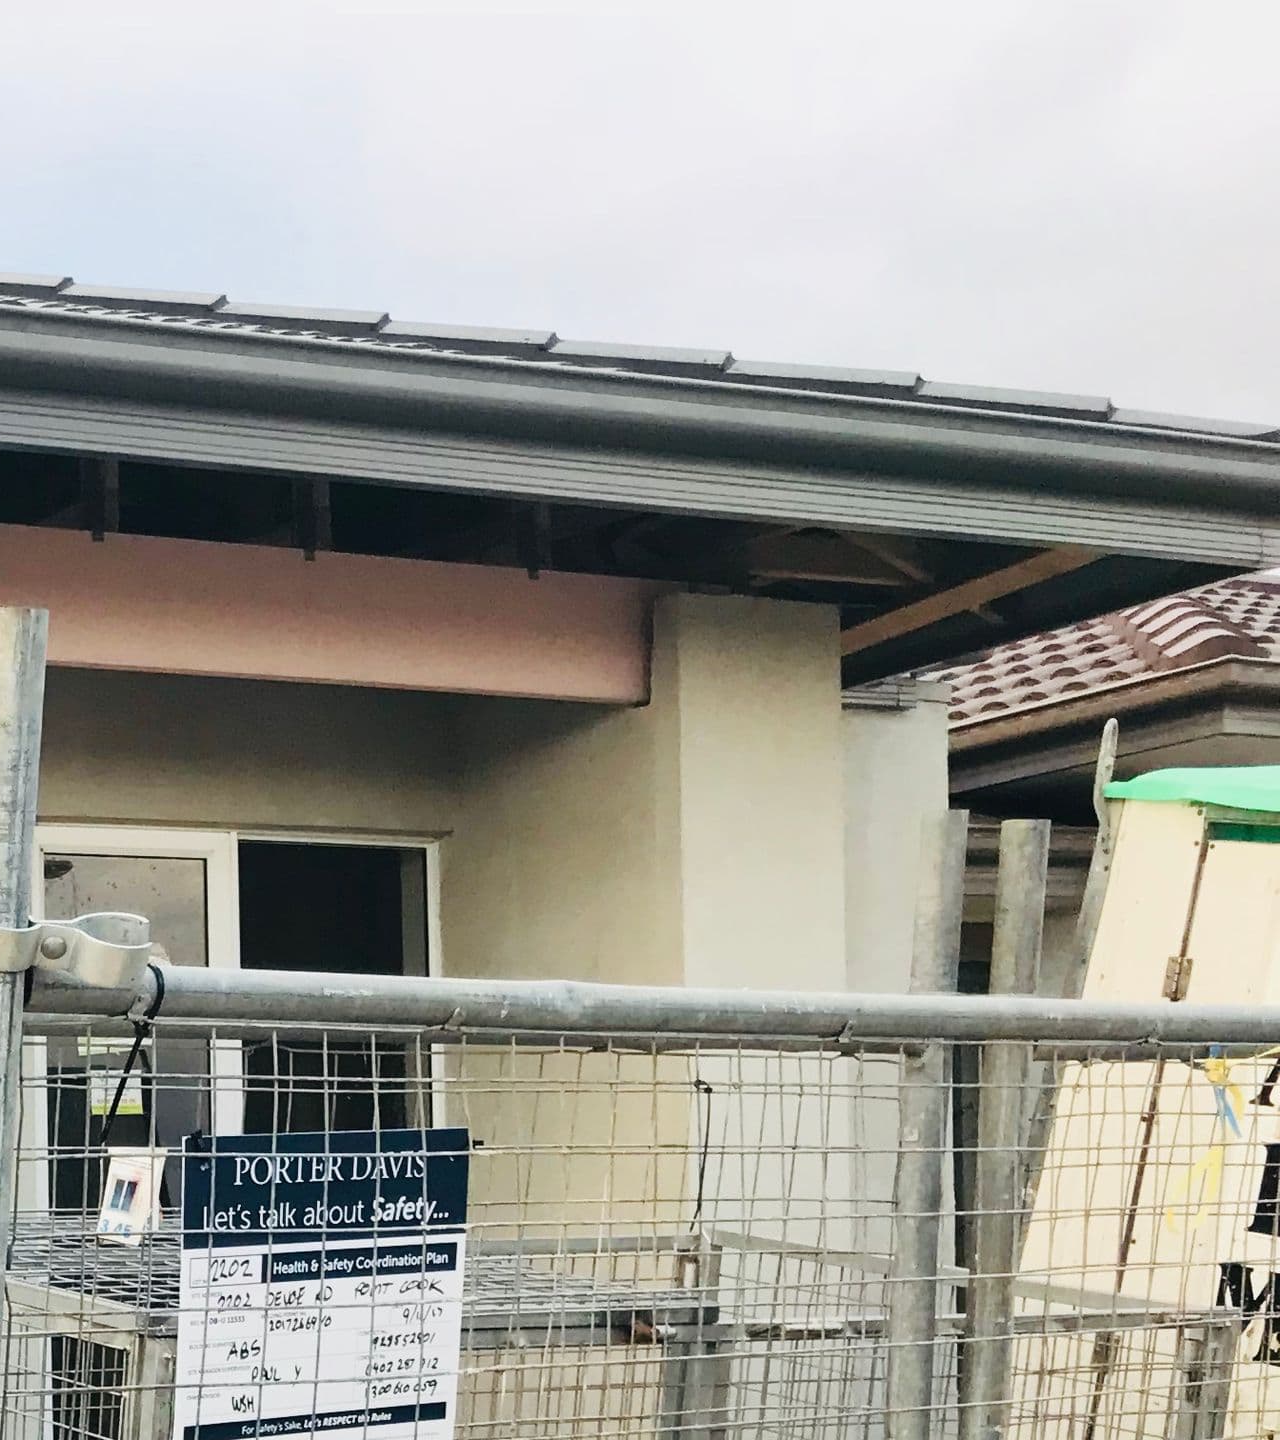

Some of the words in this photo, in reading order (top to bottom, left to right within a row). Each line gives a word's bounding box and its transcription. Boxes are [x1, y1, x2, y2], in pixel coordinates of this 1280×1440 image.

[234, 1155, 344, 1186] PORTER
[351, 1151, 426, 1179] DAVIS
[203, 1203, 251, 1231] Let's
[258, 1201, 297, 1229] talk
[304, 1200, 365, 1227] about
[370, 1195, 450, 1226] Safety...
[273, 1257, 309, 1275] Health
[311, 1259, 319, 1272] &
[321, 1256, 354, 1275] Safety
[356, 1252, 424, 1271] Coordination
[426, 1251, 449, 1266] Plan
[227, 1339, 261, 1361] ABS
[241, 1424, 254, 1435] For
[256, 1422, 283, 1436] afety's
[323, 1414, 358, 1427] RESPECT
